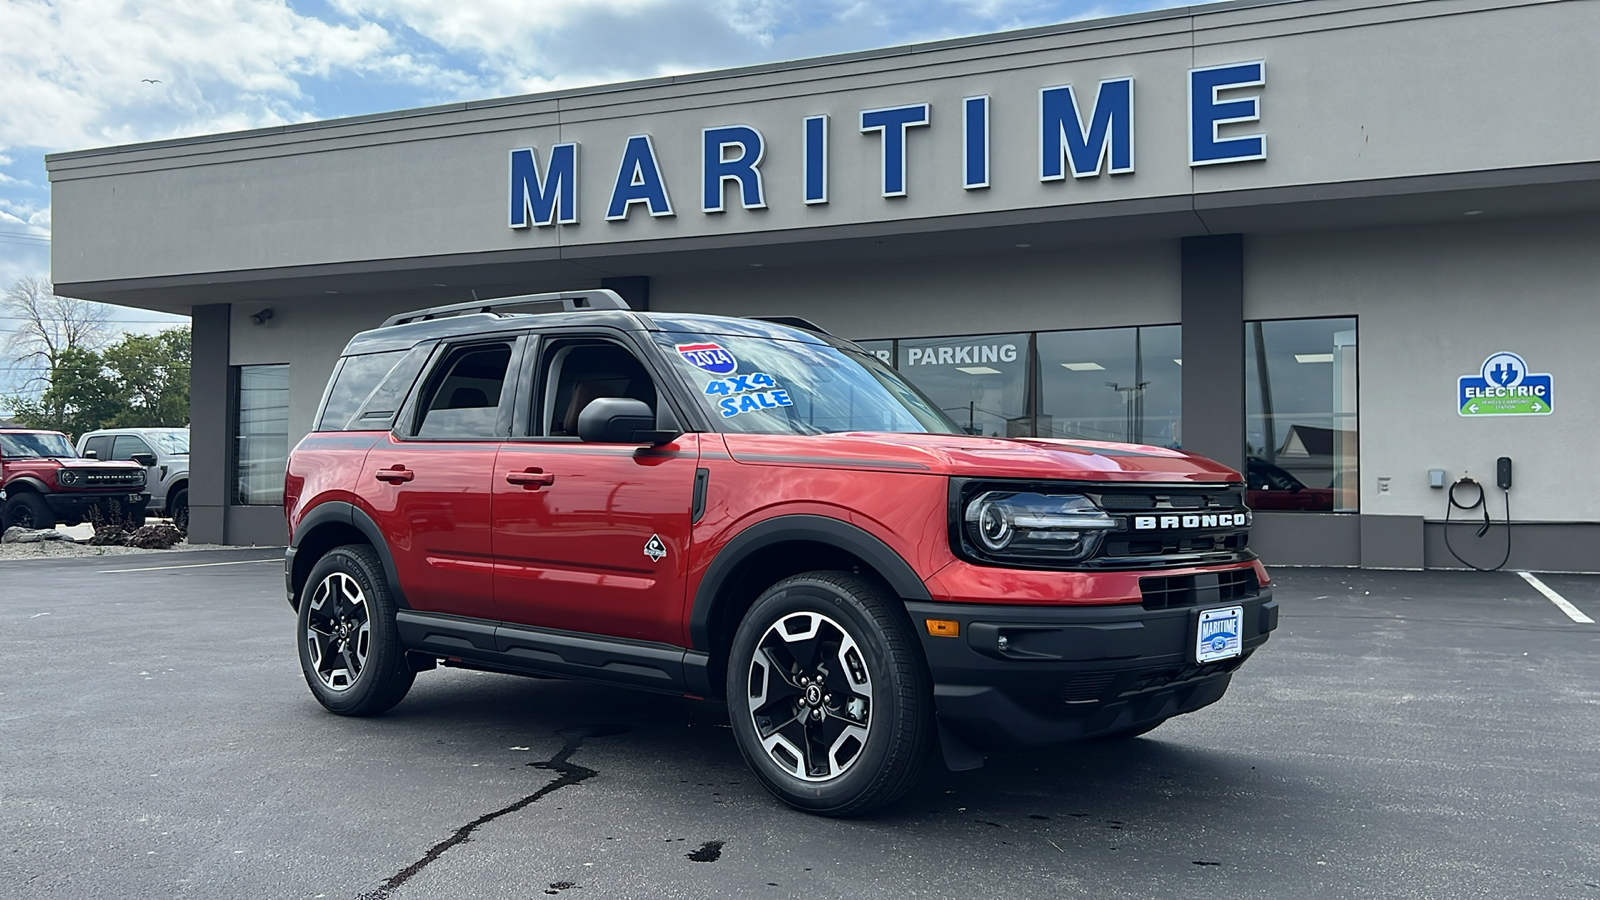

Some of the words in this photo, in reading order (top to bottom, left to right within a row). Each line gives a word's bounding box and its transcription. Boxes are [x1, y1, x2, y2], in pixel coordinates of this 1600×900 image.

[508, 59, 1268, 230] MARITIME
[687, 348, 732, 367] 2024
[908, 344, 1017, 366] PARKING
[1465, 385, 1546, 398] ELECTRIC
[719, 389, 793, 418] SALE
[1135, 513, 1245, 529] BRONCO
[347, 560, 370, 590] MICHELIN
[1202, 618, 1237, 641] MARITIME
